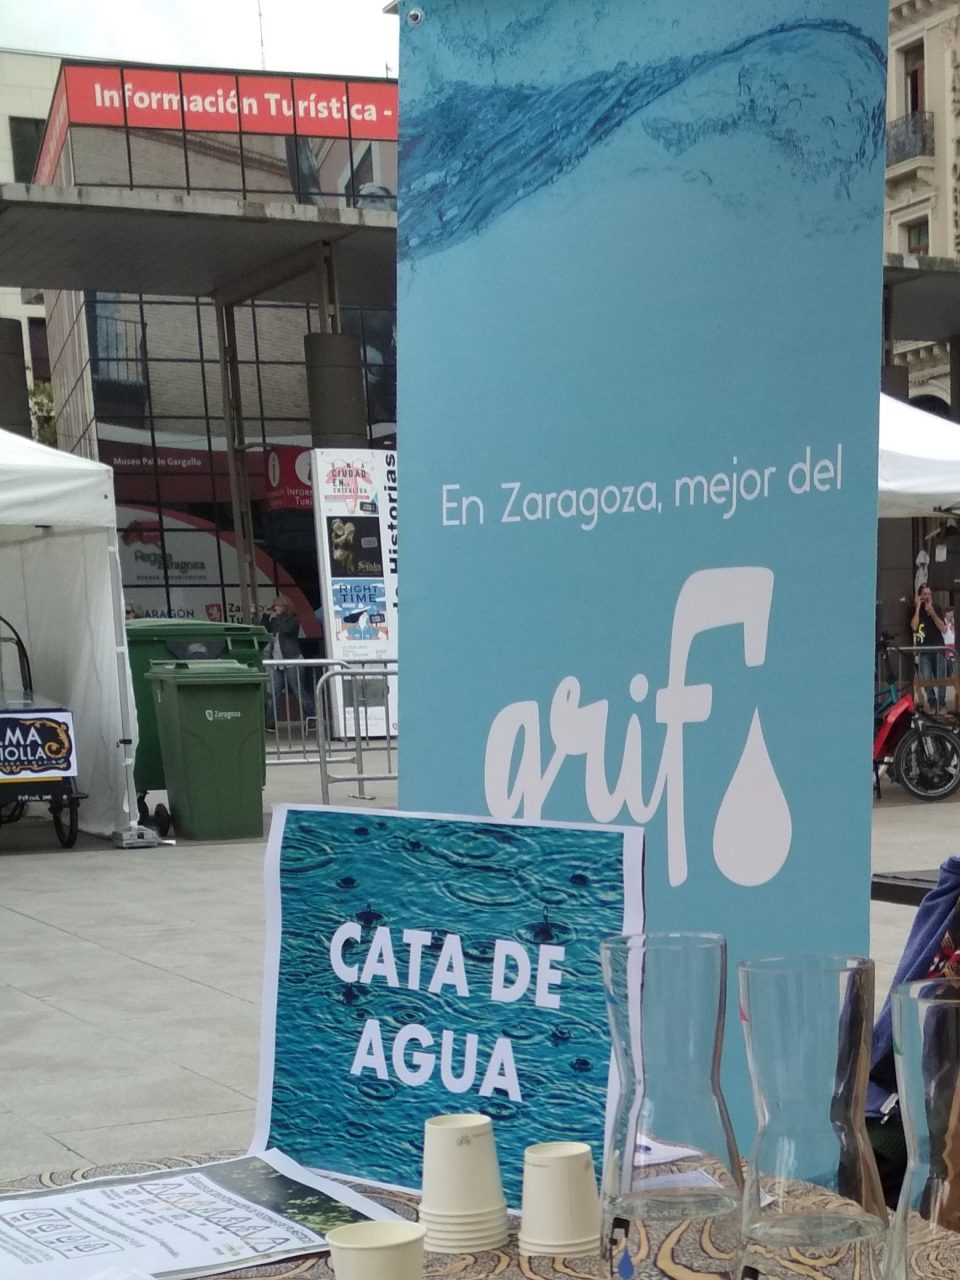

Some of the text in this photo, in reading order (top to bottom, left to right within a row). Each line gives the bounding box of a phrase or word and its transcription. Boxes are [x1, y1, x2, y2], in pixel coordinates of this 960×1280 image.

[94, 83, 257, 115] Información
[264, 93, 377, 121] Turística
[331, 470, 366, 478] CIUDAD
[442, 443, 843, 531] En Zaragoza, mejor del
[339, 584, 379, 594] RIGHT
[341, 594, 377, 603] TIME
[329, 921, 566, 1008] CATA DE
[350, 1018, 523, 1102] AGUA
